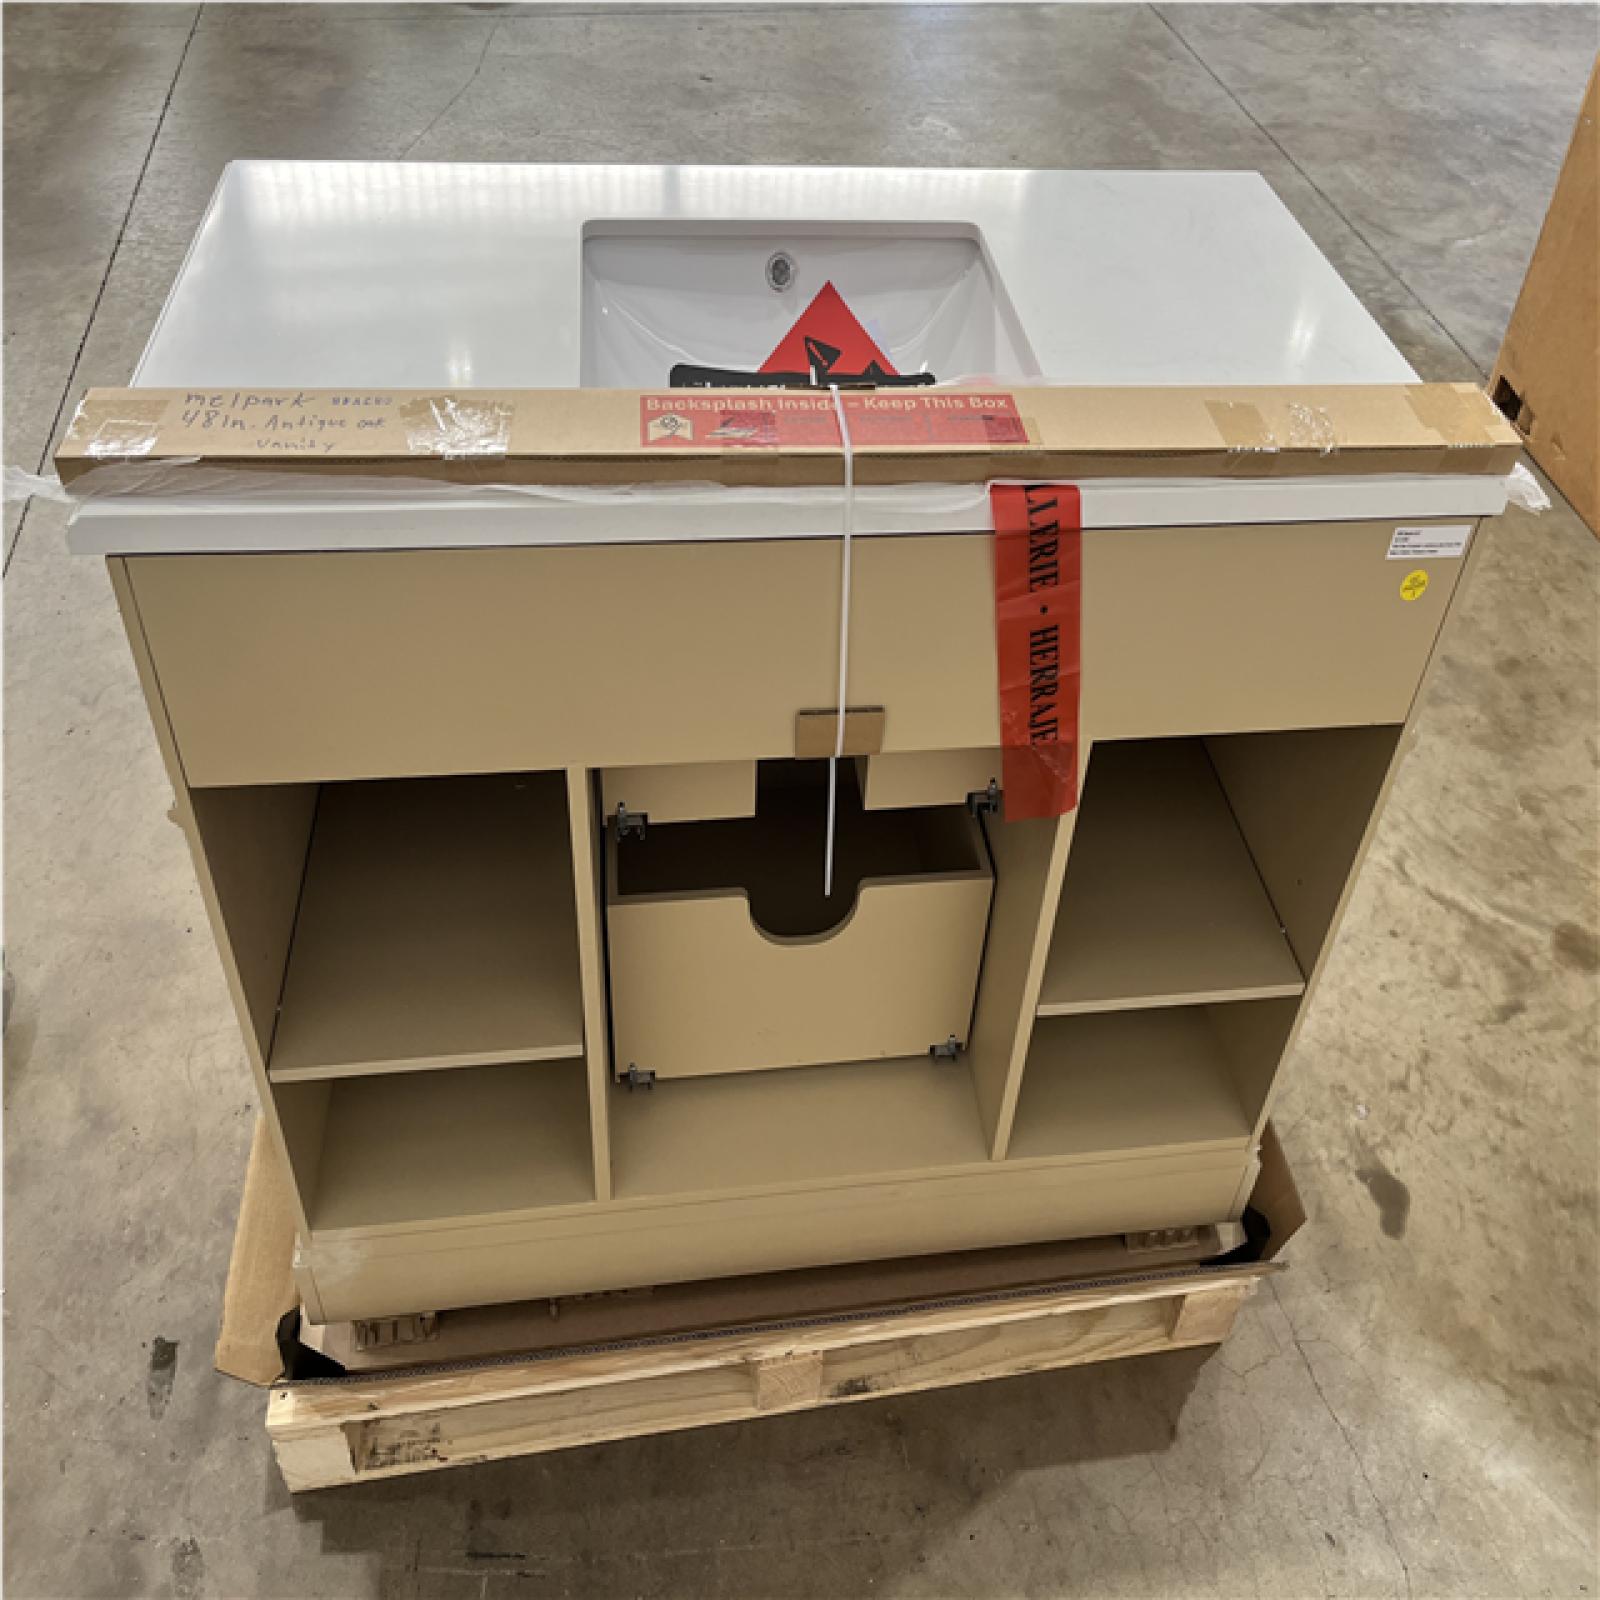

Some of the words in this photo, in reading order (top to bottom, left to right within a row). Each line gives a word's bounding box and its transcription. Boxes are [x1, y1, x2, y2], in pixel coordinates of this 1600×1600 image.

[646, 397, 773, 413] Backsplash
[863, 396, 917, 411] Keep
[920, 396, 964, 409] This
[968, 396, 1008, 409] Box
